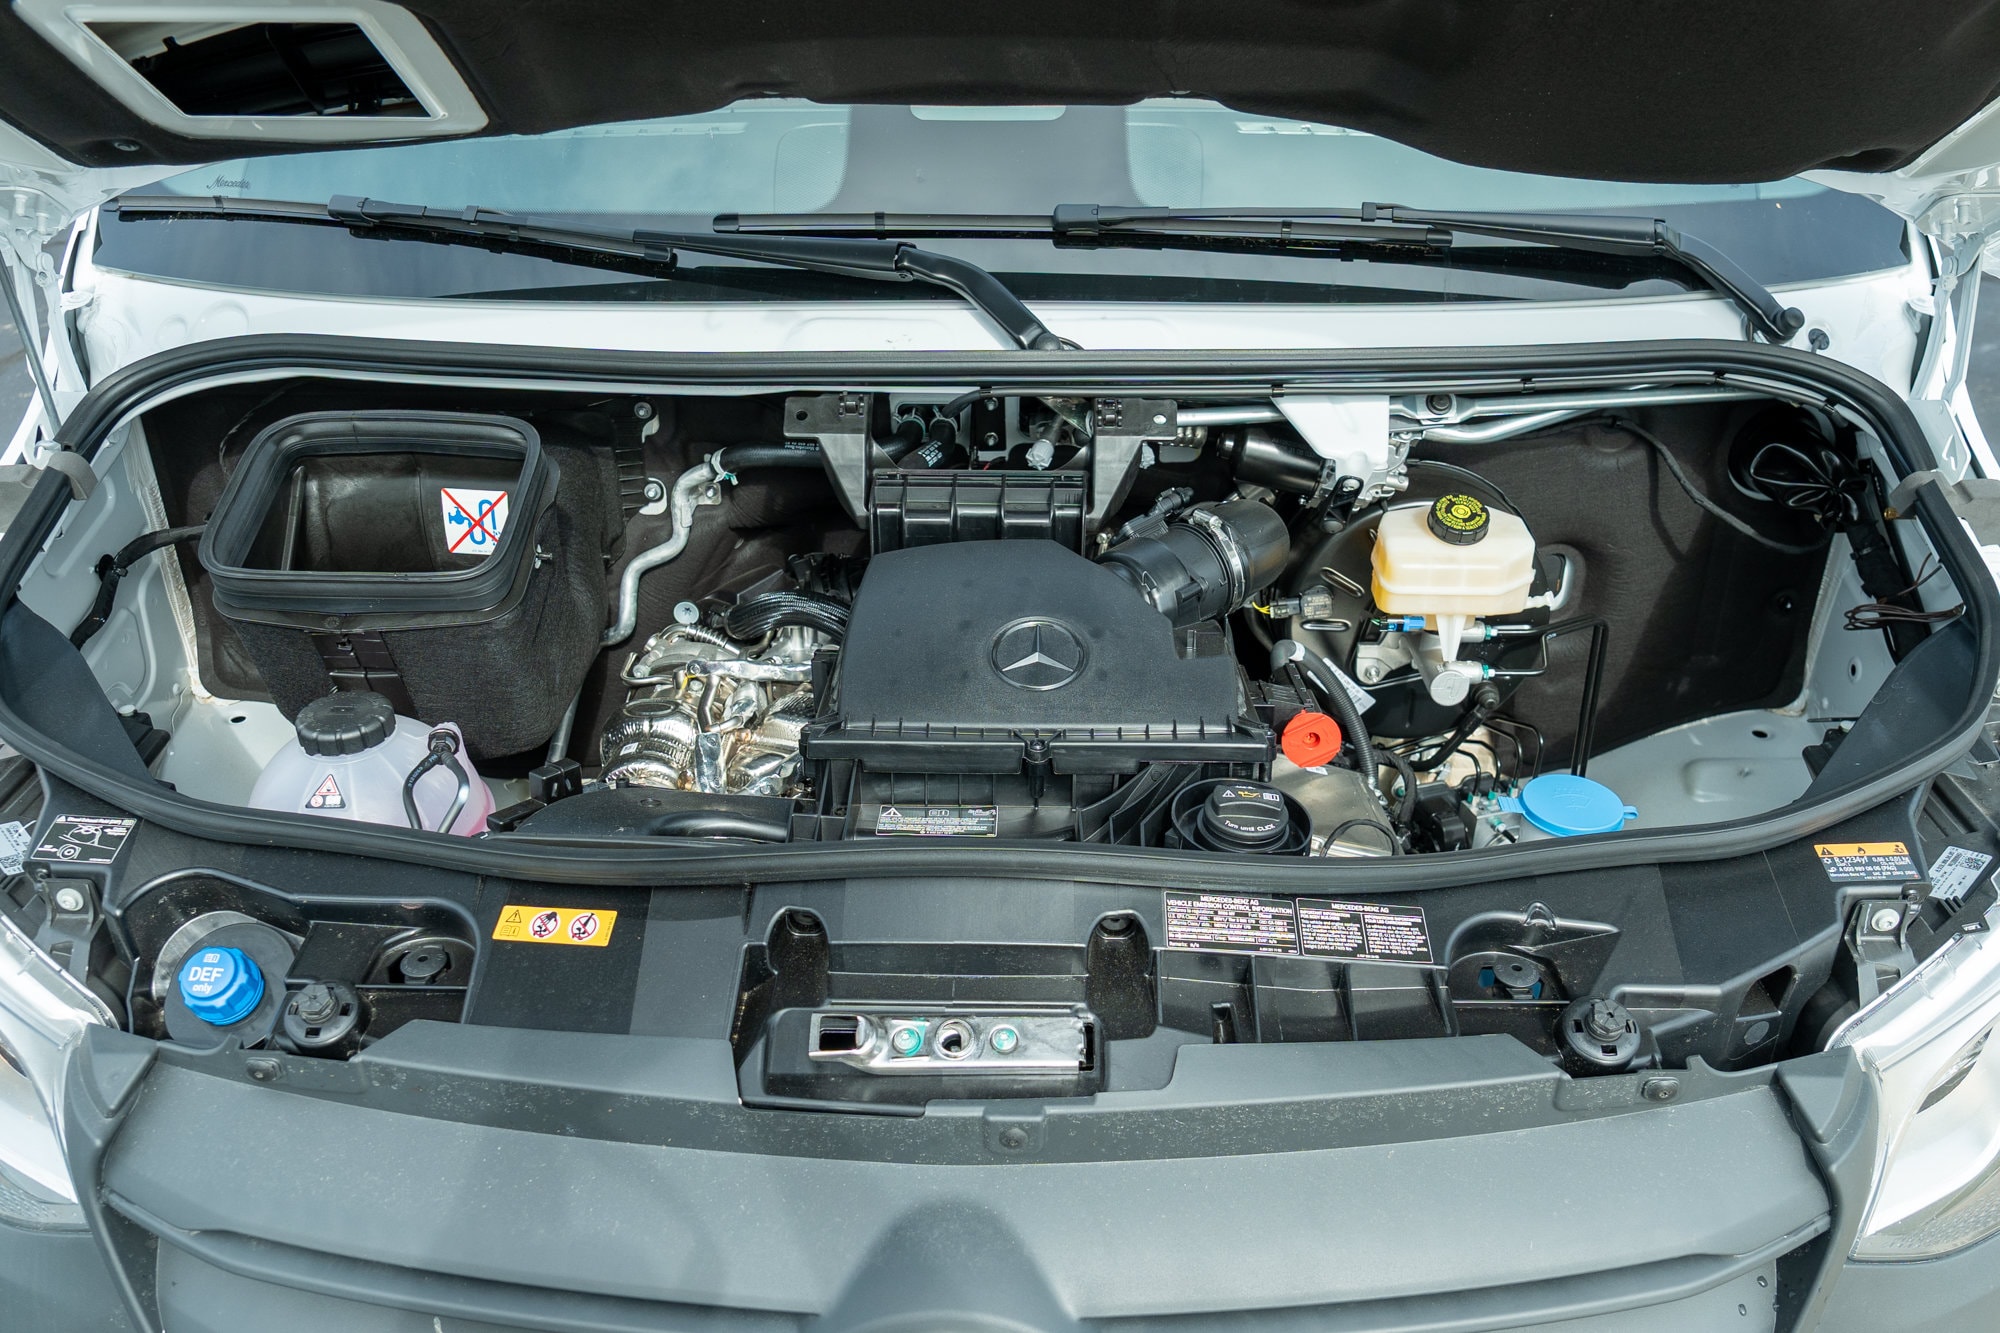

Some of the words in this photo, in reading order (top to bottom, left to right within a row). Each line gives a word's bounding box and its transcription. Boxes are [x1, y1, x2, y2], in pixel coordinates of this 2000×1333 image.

[1224, 820, 1238, 829] Turn
[1833, 856, 1868, 864] R-1234yf
[1252, 906, 1292, 914] INFORMATION
[188, 966, 225, 982] DEF
[192, 983, 213, 994] only
